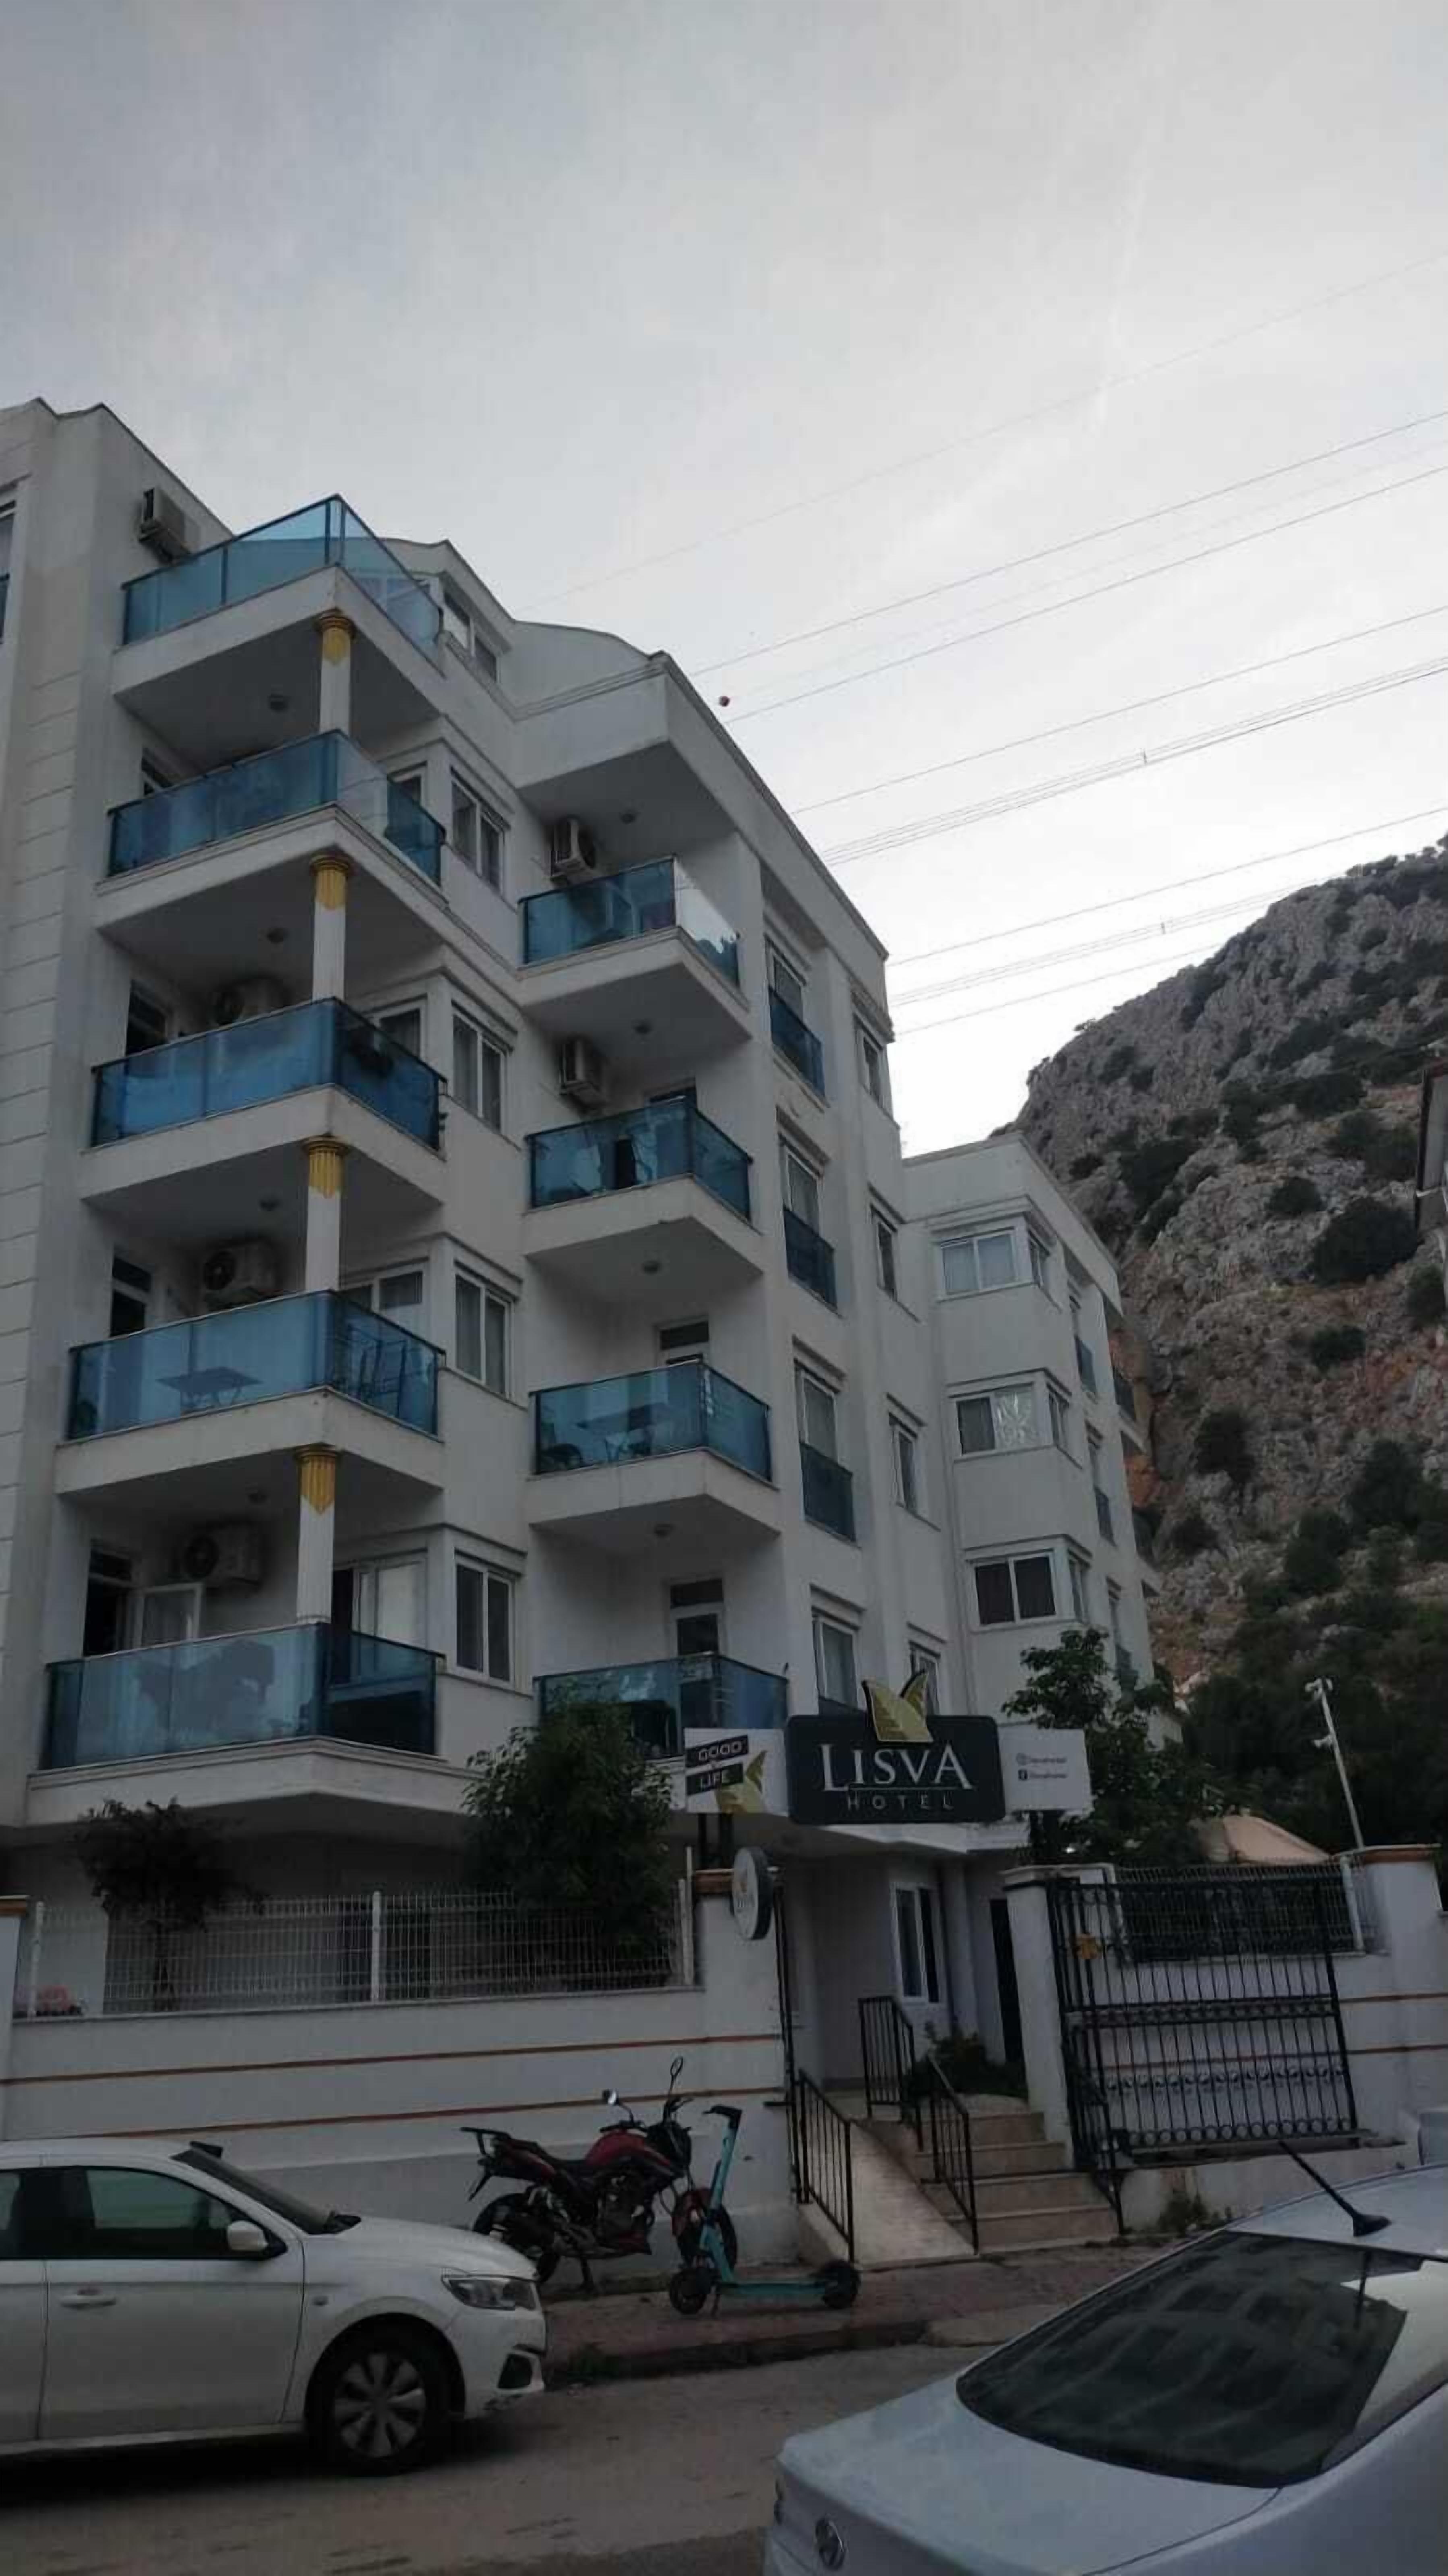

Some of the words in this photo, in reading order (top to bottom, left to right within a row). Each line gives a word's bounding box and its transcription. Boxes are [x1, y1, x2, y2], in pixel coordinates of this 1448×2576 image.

[699, 1741, 743, 1761] GOOD
[819, 1743, 974, 1791] LISVA
[847, 1794, 954, 1810] HOTEL
